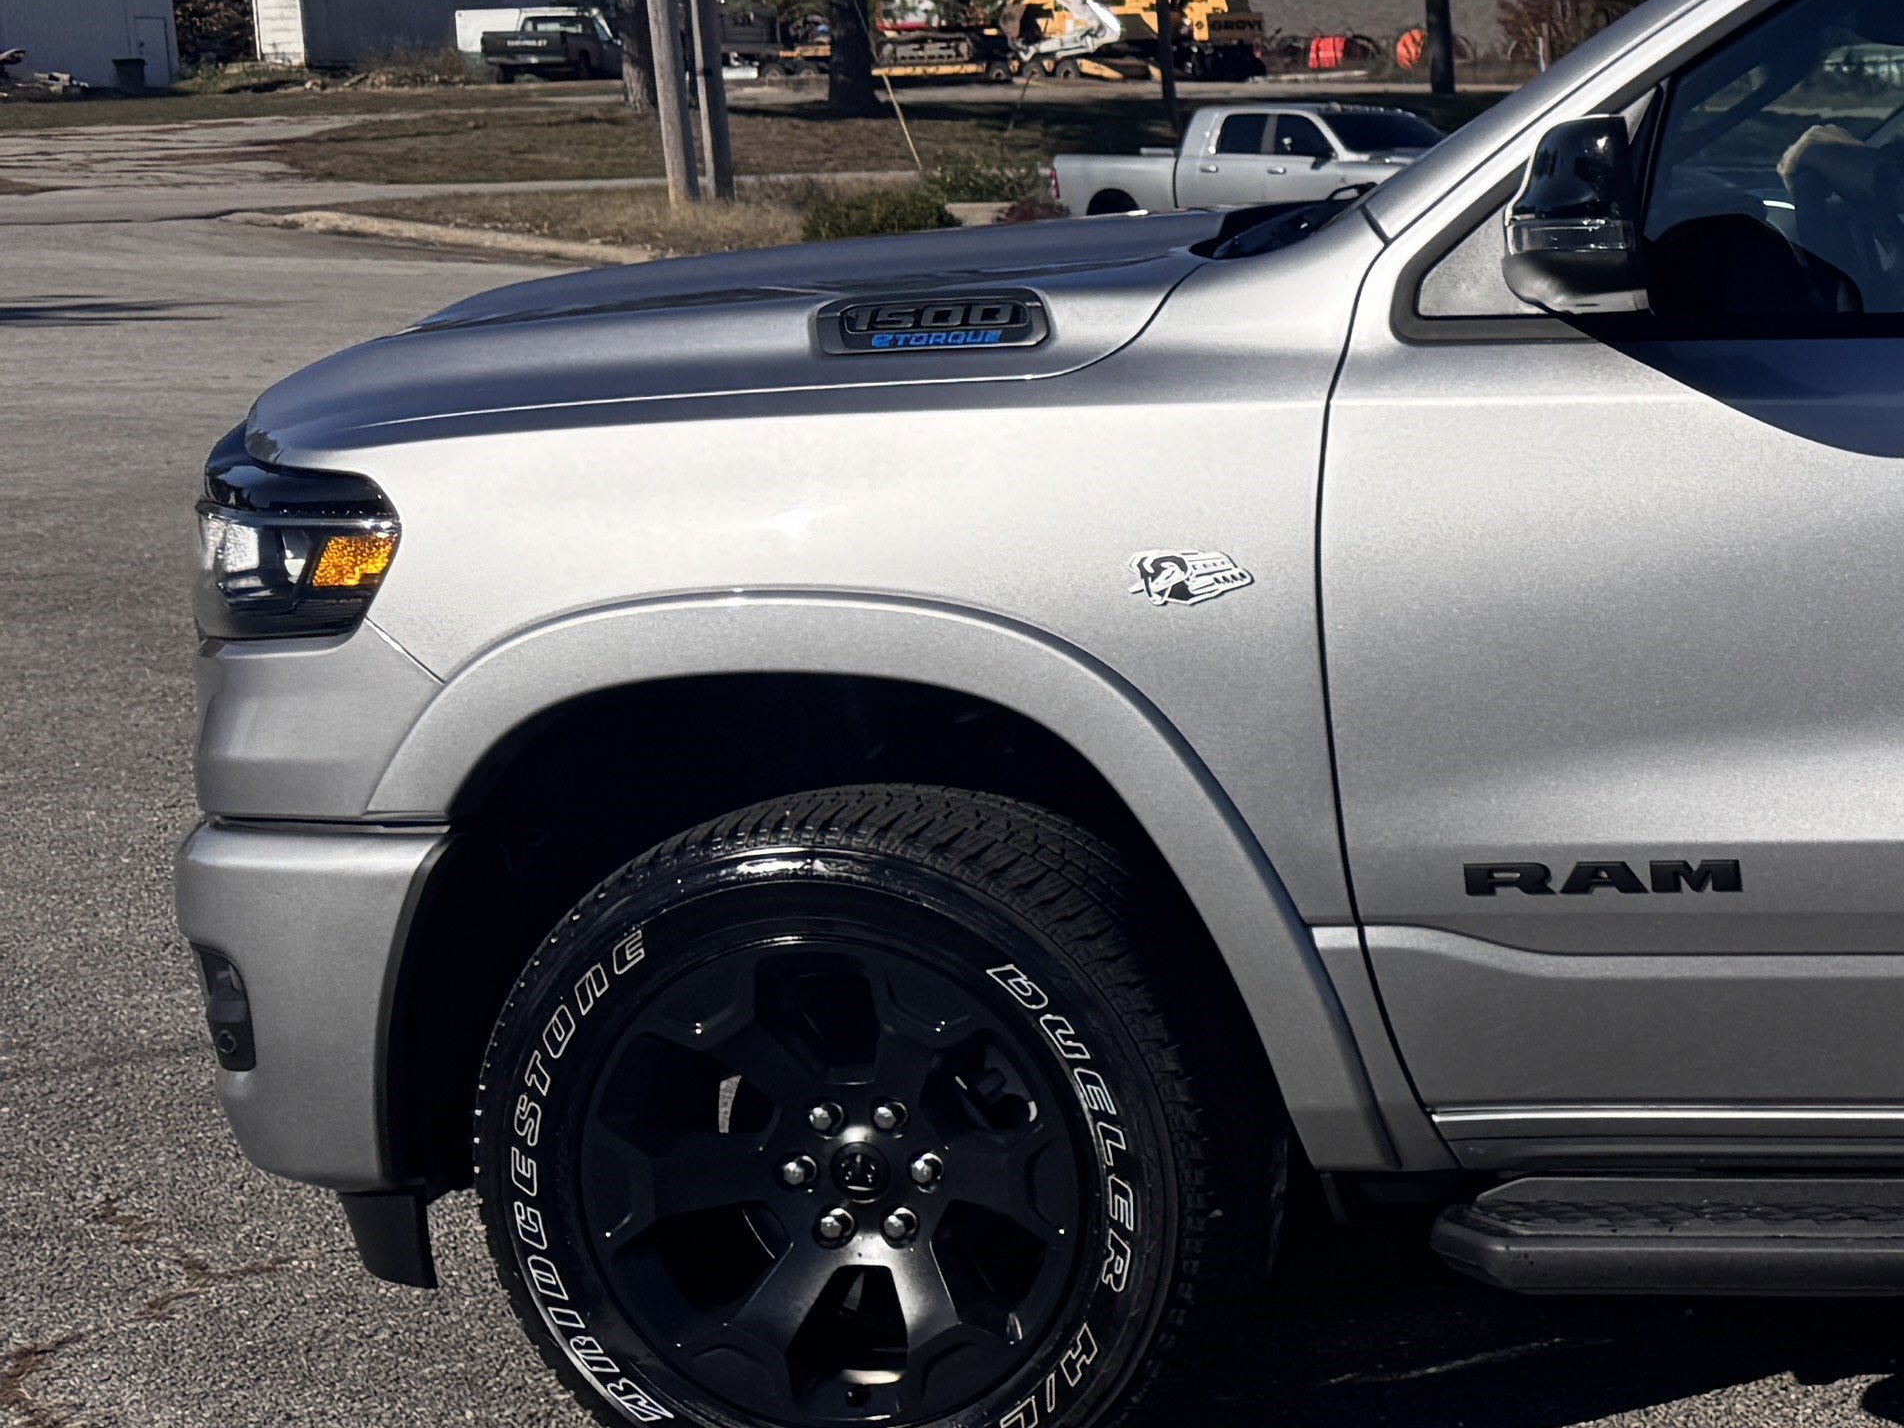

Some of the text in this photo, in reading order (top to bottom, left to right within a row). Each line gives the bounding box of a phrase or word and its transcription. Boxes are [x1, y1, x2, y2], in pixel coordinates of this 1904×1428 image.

[846, 303, 1012, 330] 1500
[1463, 859, 1744, 897] RAM
[511, 928, 674, 1424] BRIDGESTONE
[986, 963, 1137, 1293] DUELER
